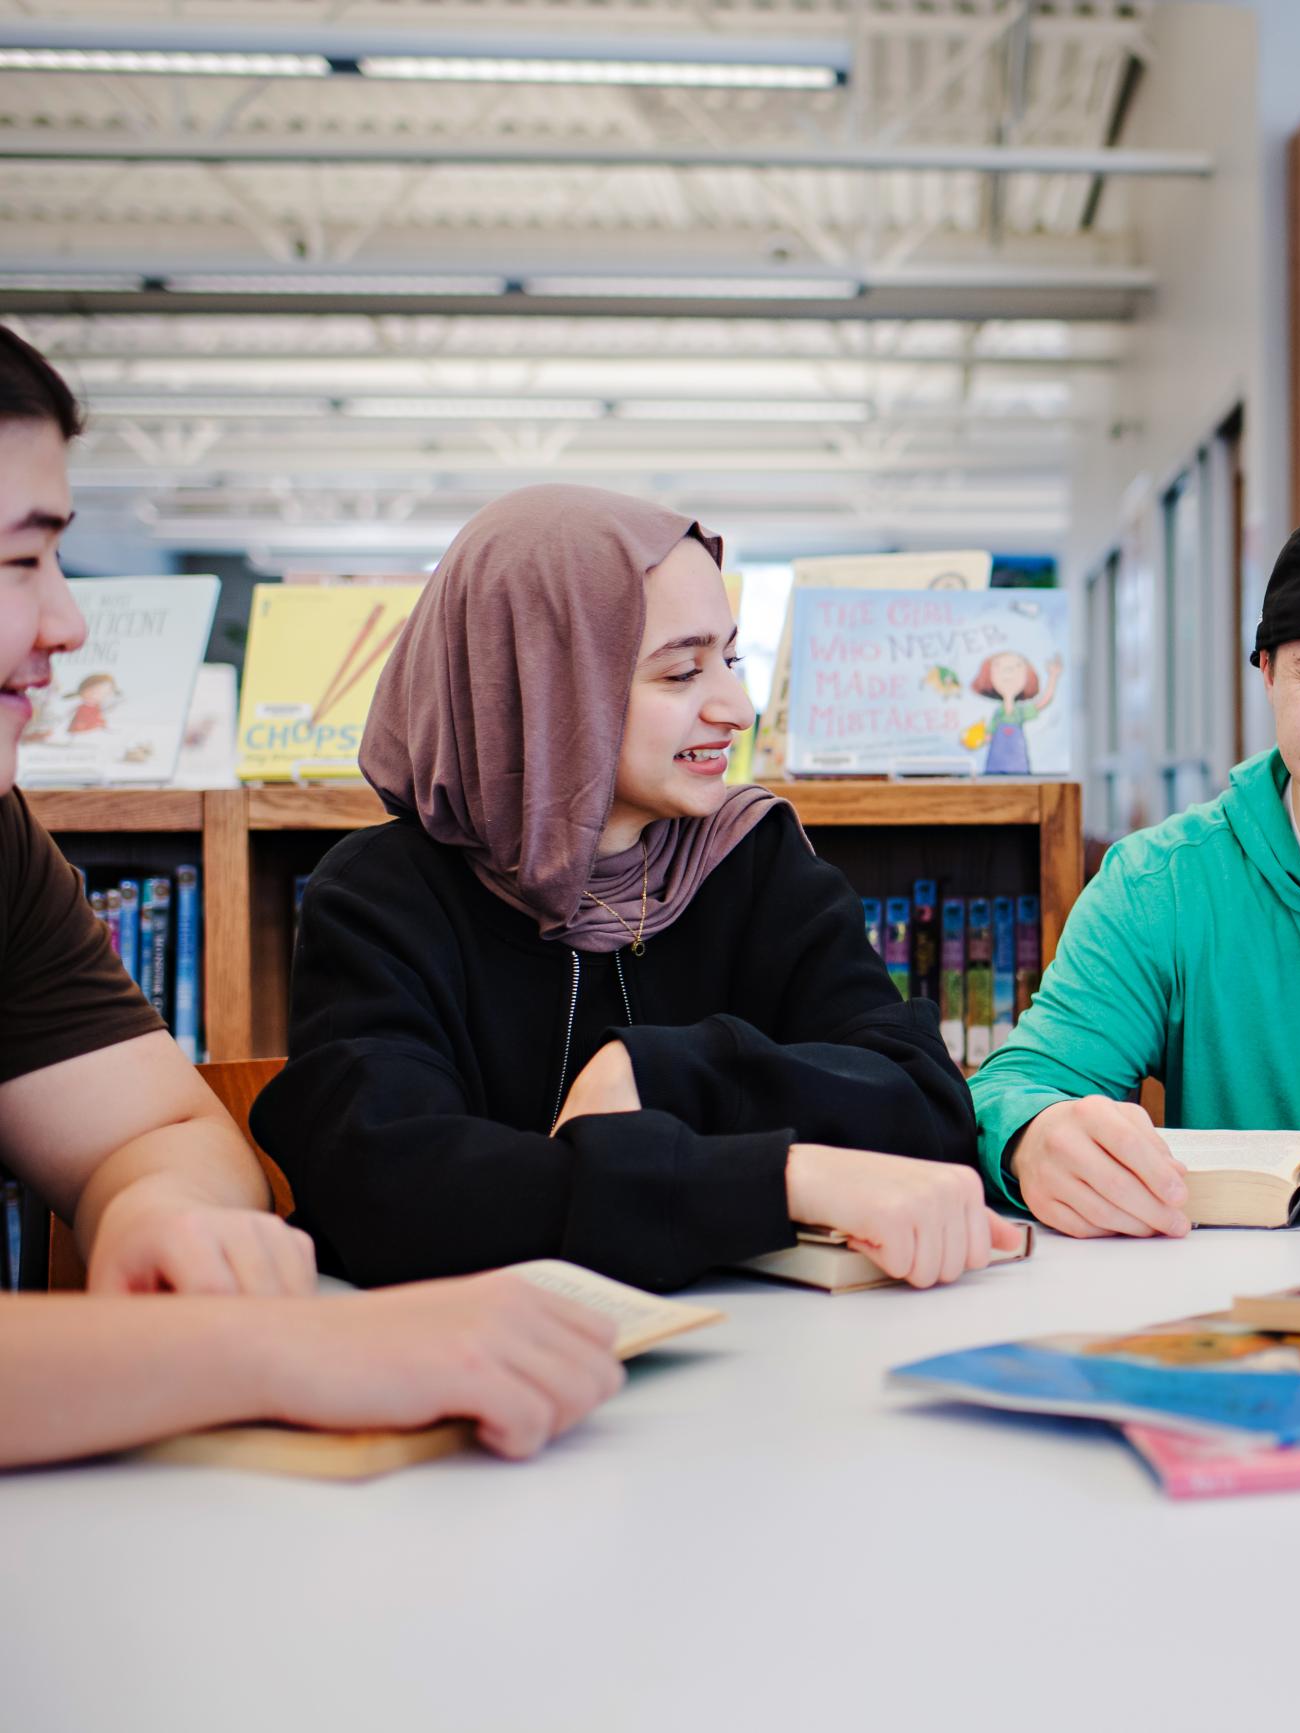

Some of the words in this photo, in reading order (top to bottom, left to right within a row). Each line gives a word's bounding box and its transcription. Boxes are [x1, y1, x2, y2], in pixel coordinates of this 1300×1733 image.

[816, 601, 876, 629] THE
[886, 598, 966, 629] GIRL
[808, 634, 881, 663] WHO
[888, 625, 1006, 662] NEVER
[815, 671, 908, 699] MADE
[246, 718, 364, 750] CHOPS
[807, 704, 960, 737] MISTAKES
